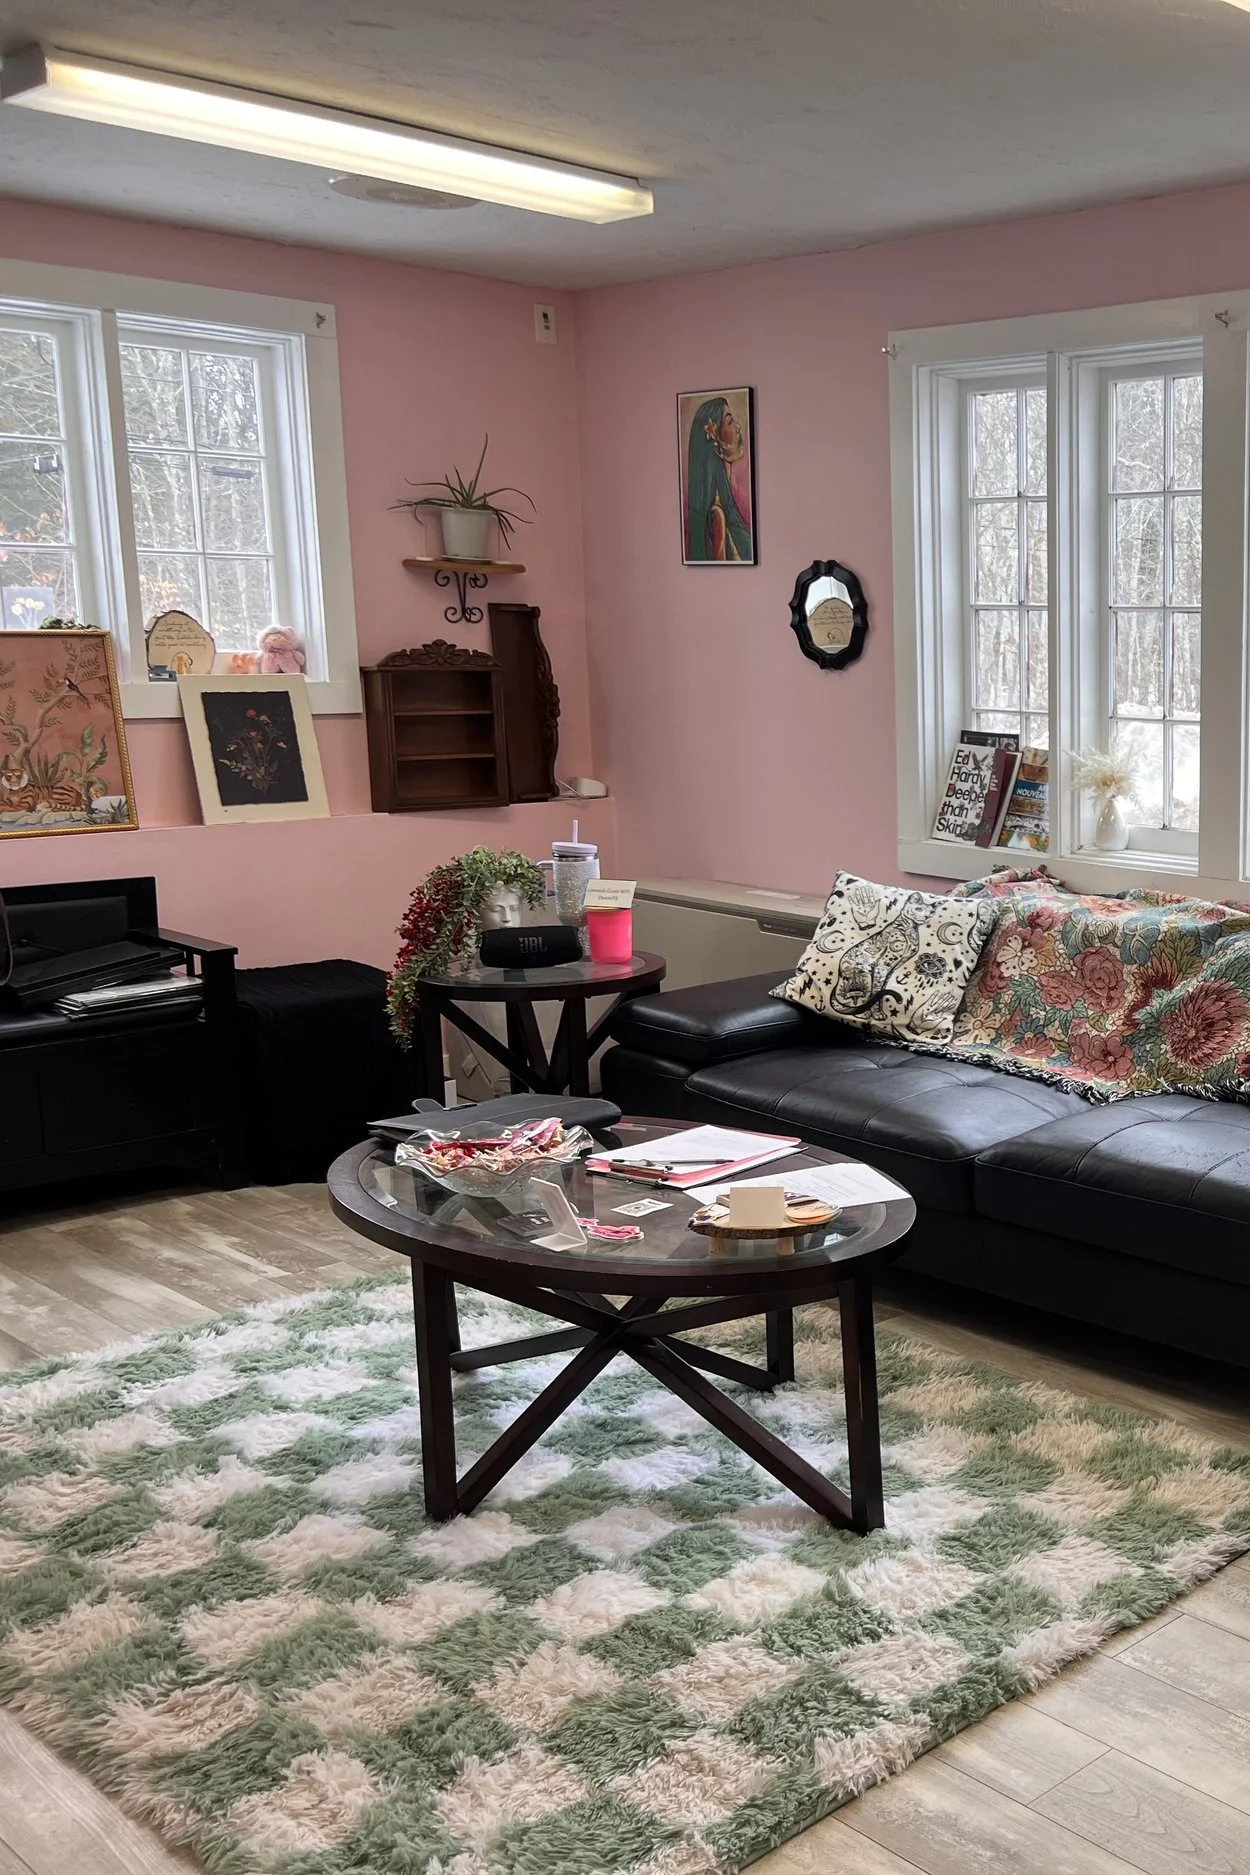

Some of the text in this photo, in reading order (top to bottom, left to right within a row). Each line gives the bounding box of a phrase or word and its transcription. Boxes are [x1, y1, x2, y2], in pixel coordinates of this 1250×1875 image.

[954, 749, 971, 766] Ed
[950, 765, 987, 787] Hardy
[941, 800, 969, 819] than
[518, 936, 548, 953] JBL
